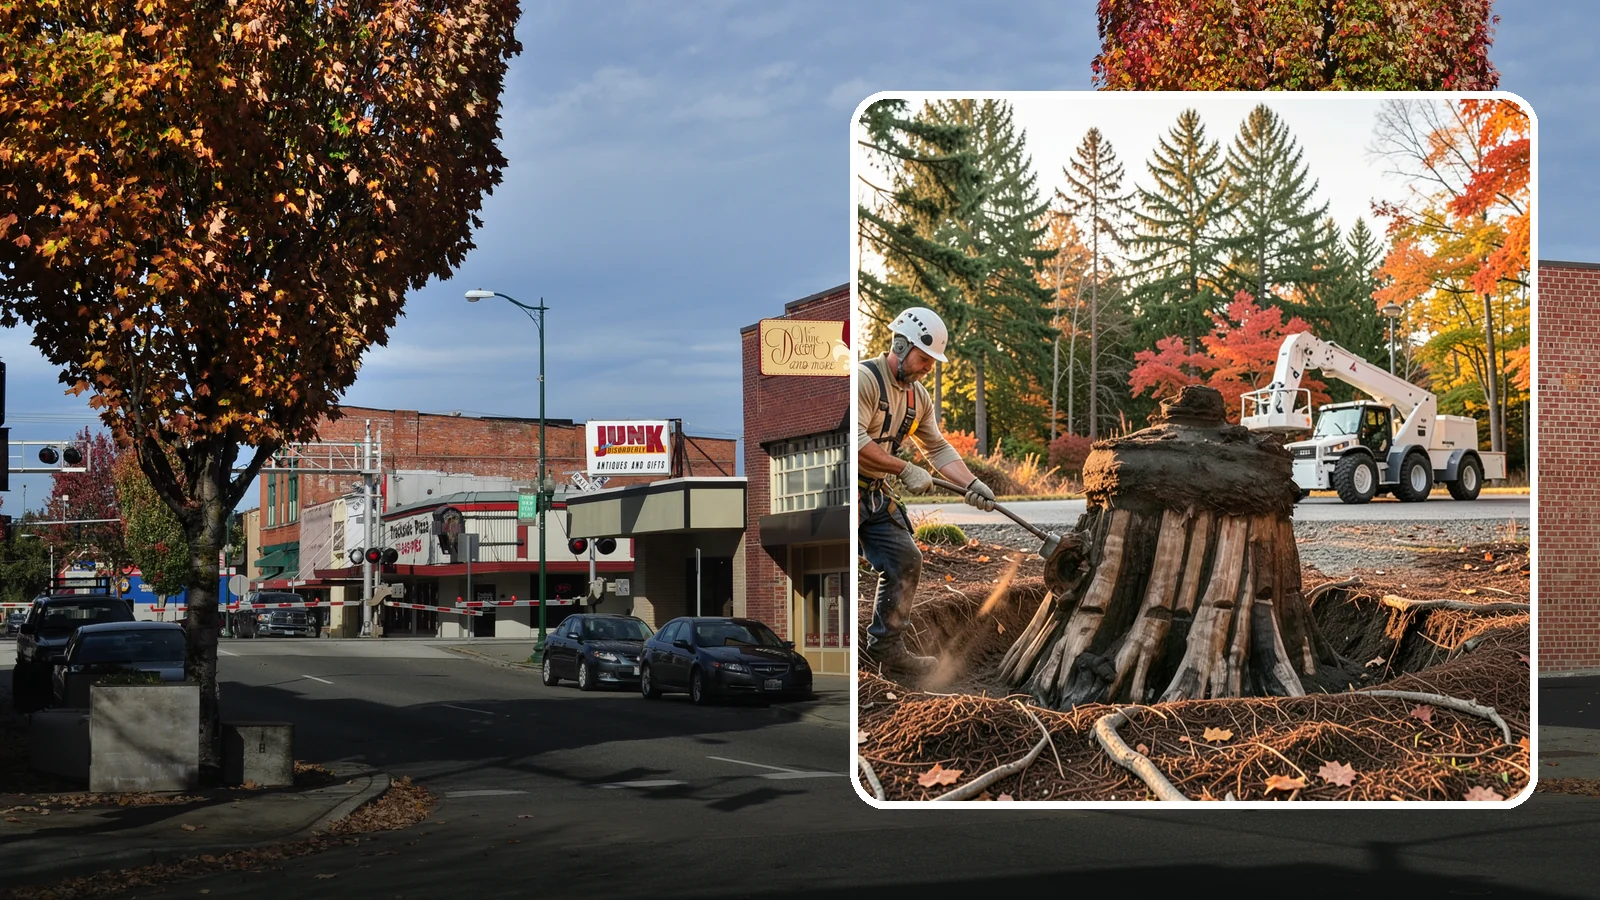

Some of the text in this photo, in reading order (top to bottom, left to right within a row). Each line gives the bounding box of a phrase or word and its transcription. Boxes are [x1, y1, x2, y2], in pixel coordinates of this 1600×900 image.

[596, 425, 665, 457] JUNK
[607, 446, 645, 454] DISORDERLY
[597, 460, 665, 470] ANTIQUES AND GIFTS
[352, 498, 364, 510] CRO
[390, 519, 429, 540] Trackside Pizza
